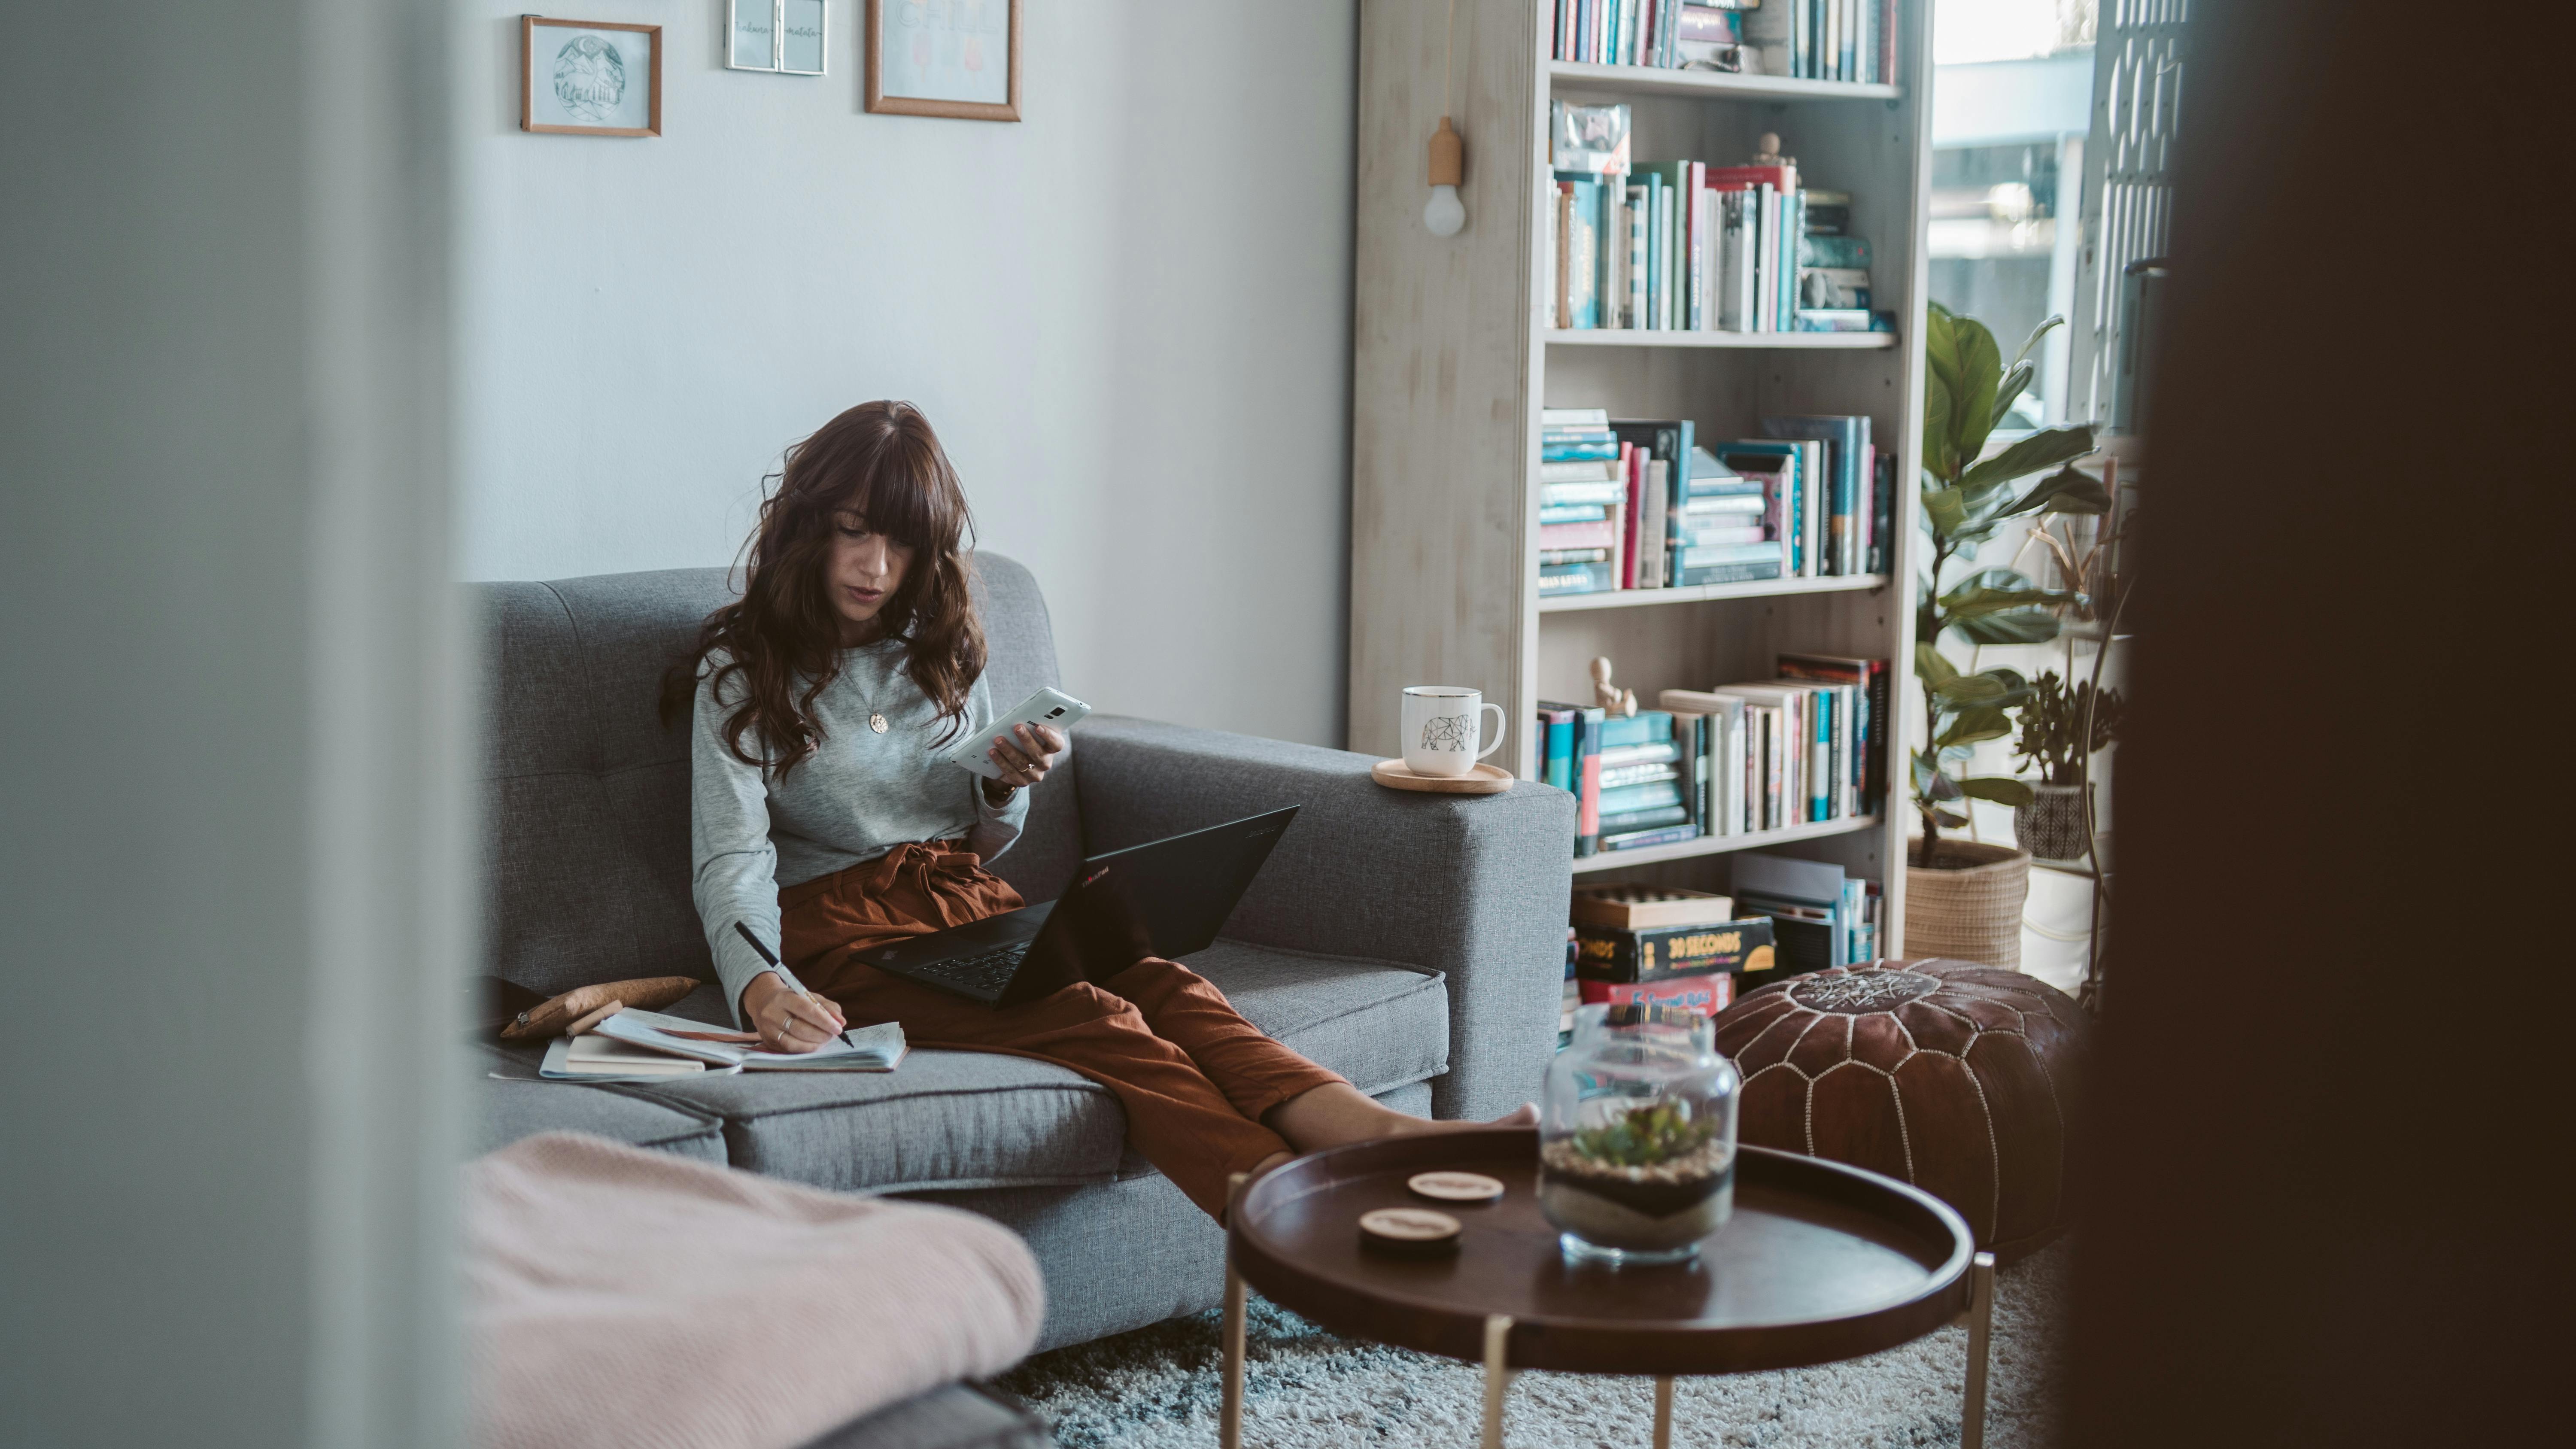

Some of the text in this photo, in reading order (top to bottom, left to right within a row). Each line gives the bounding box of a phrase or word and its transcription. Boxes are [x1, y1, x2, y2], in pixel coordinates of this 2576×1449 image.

[735, 21, 821, 37] hakuna matata
[1082, 866, 1109, 888] ThinkPad
[1668, 937, 1686, 959] 30
[1686, 931, 1742, 957] SECONDS
